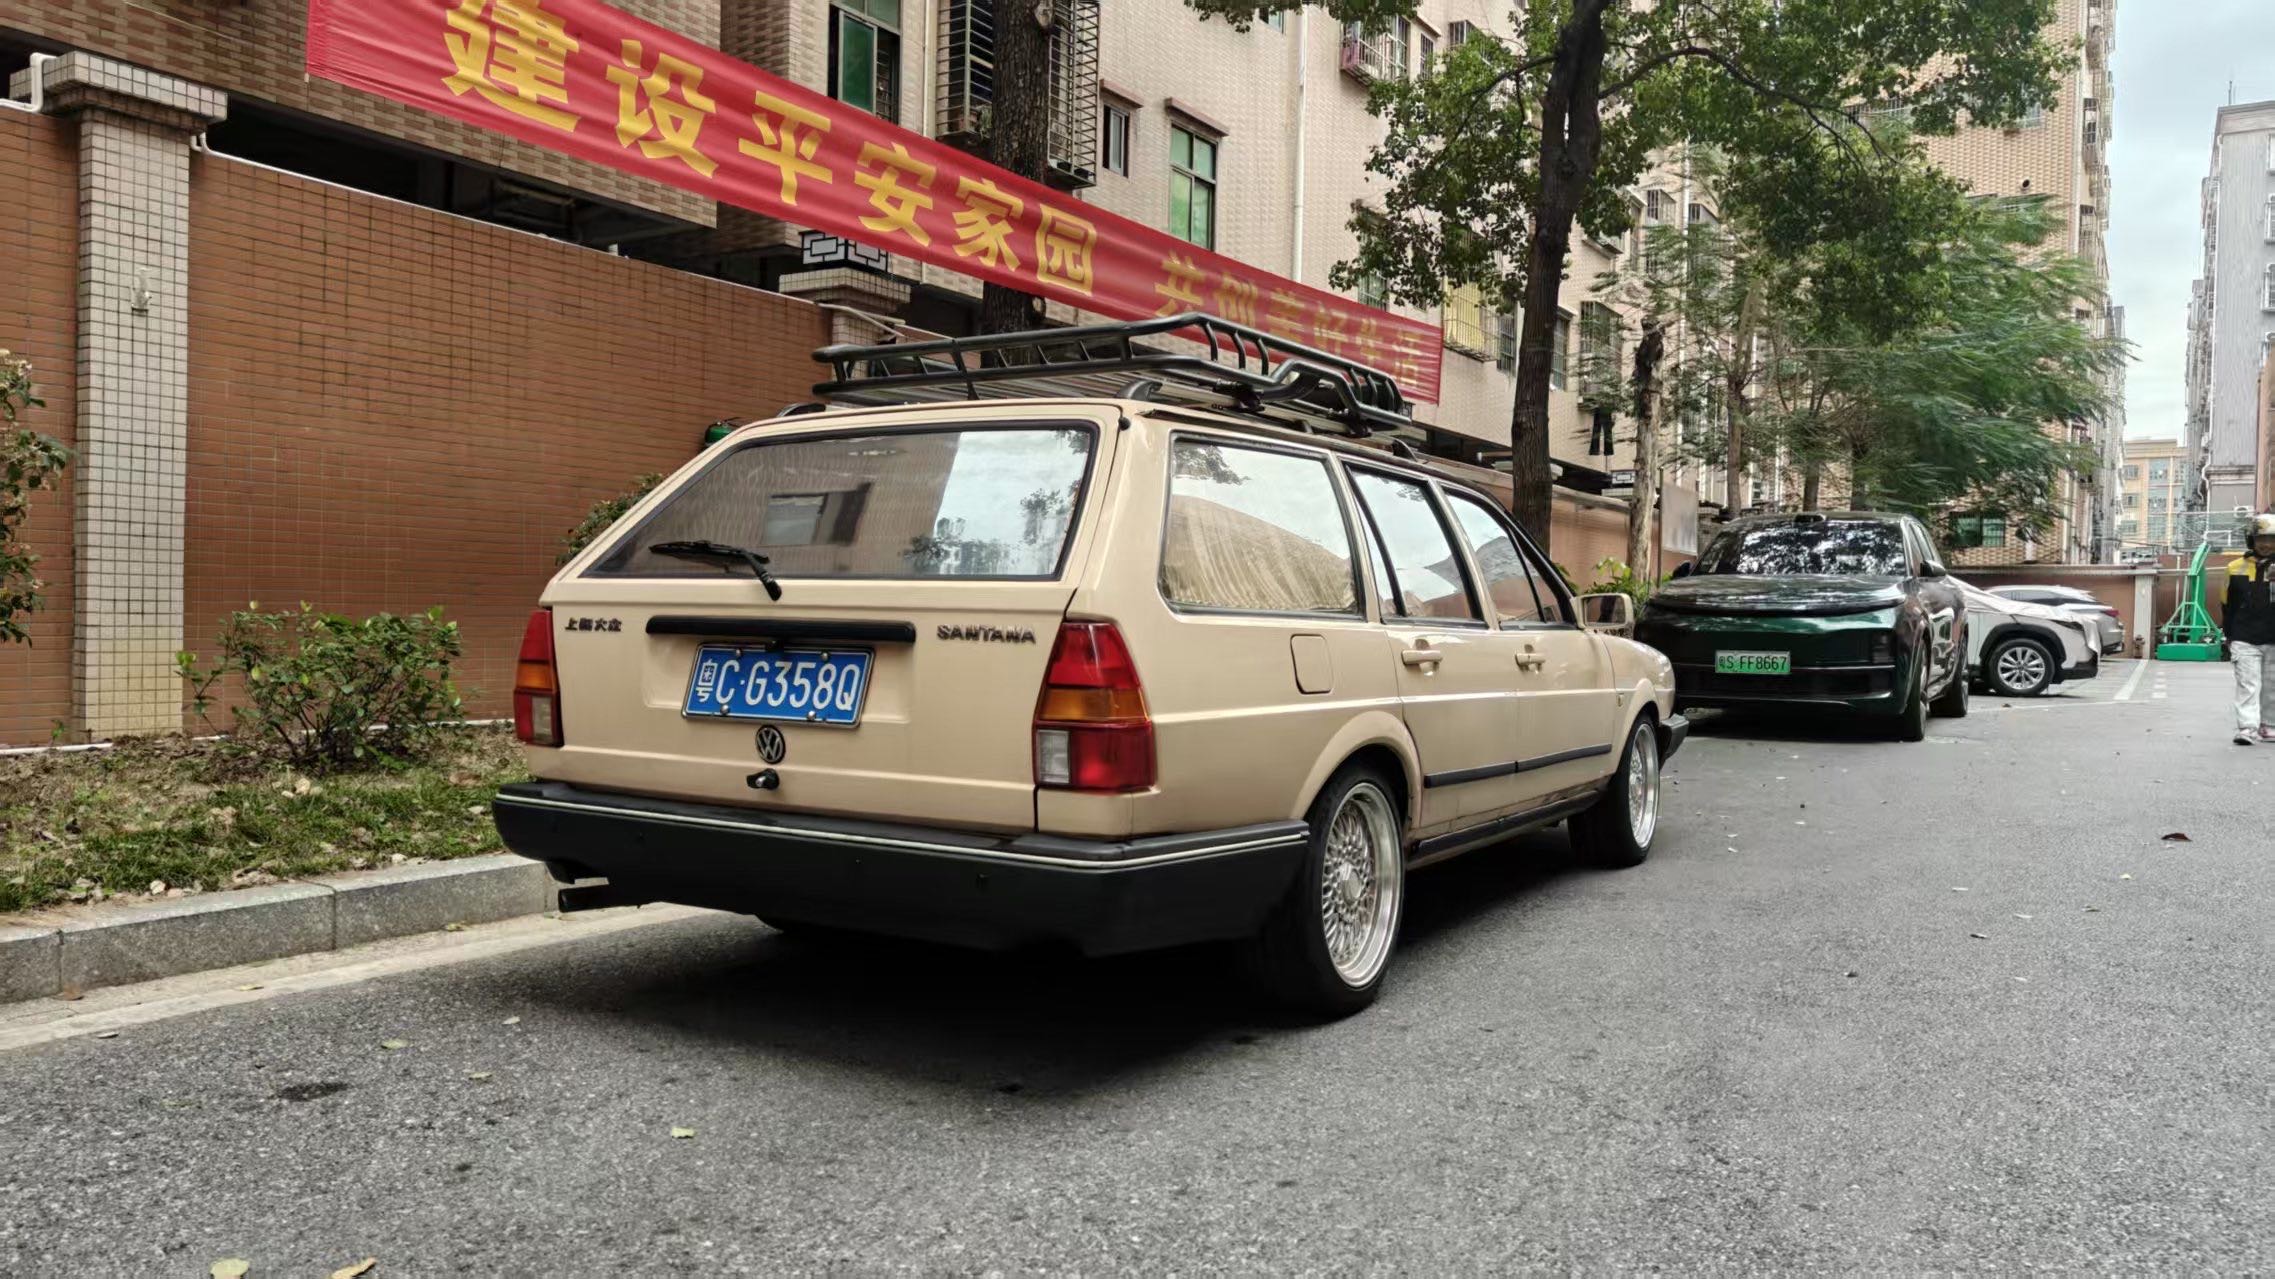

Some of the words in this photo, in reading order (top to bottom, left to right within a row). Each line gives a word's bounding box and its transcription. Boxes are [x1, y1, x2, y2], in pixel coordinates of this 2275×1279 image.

[441, 0, 1097, 297] 建设平安家园
[937, 624, 1036, 644] SANTANA
